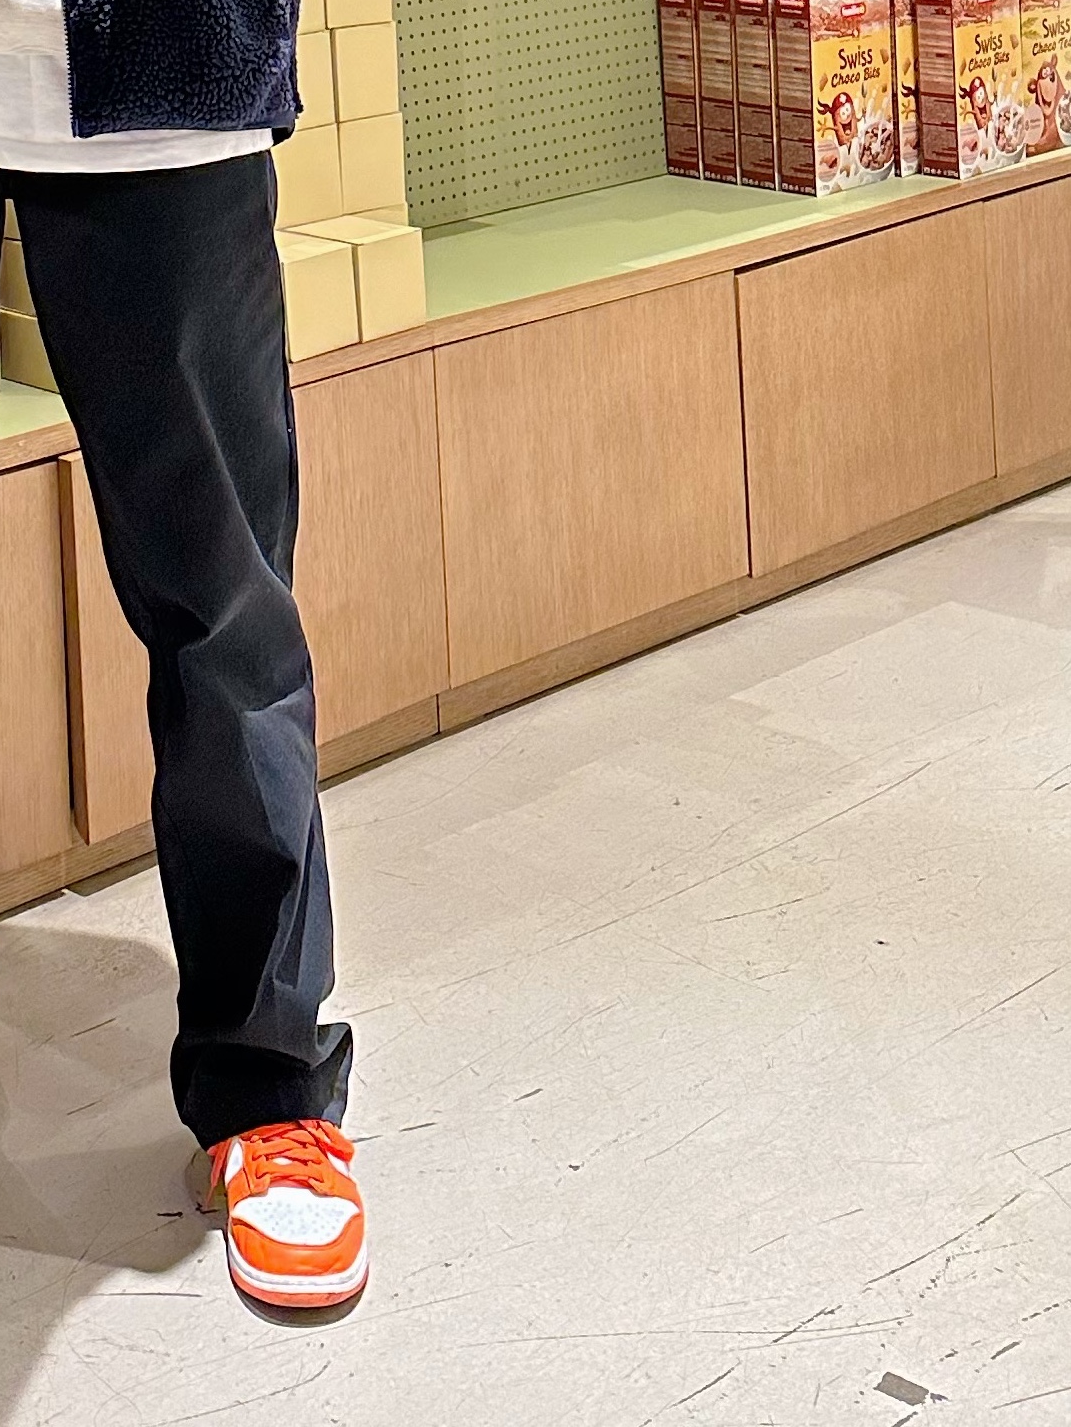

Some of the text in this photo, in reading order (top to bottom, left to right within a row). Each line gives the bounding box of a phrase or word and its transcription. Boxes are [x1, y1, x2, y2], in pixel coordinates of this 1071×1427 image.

[1042, 14, 1071, 39] Swiss
[975, 30, 1003, 55] Swiss
[1032, 39, 1056, 56] Choco
[837, 44, 873, 71] Swiss
[968, 51, 1010, 73] Choco Bits
[831, 66, 881, 89] Choco Bits
